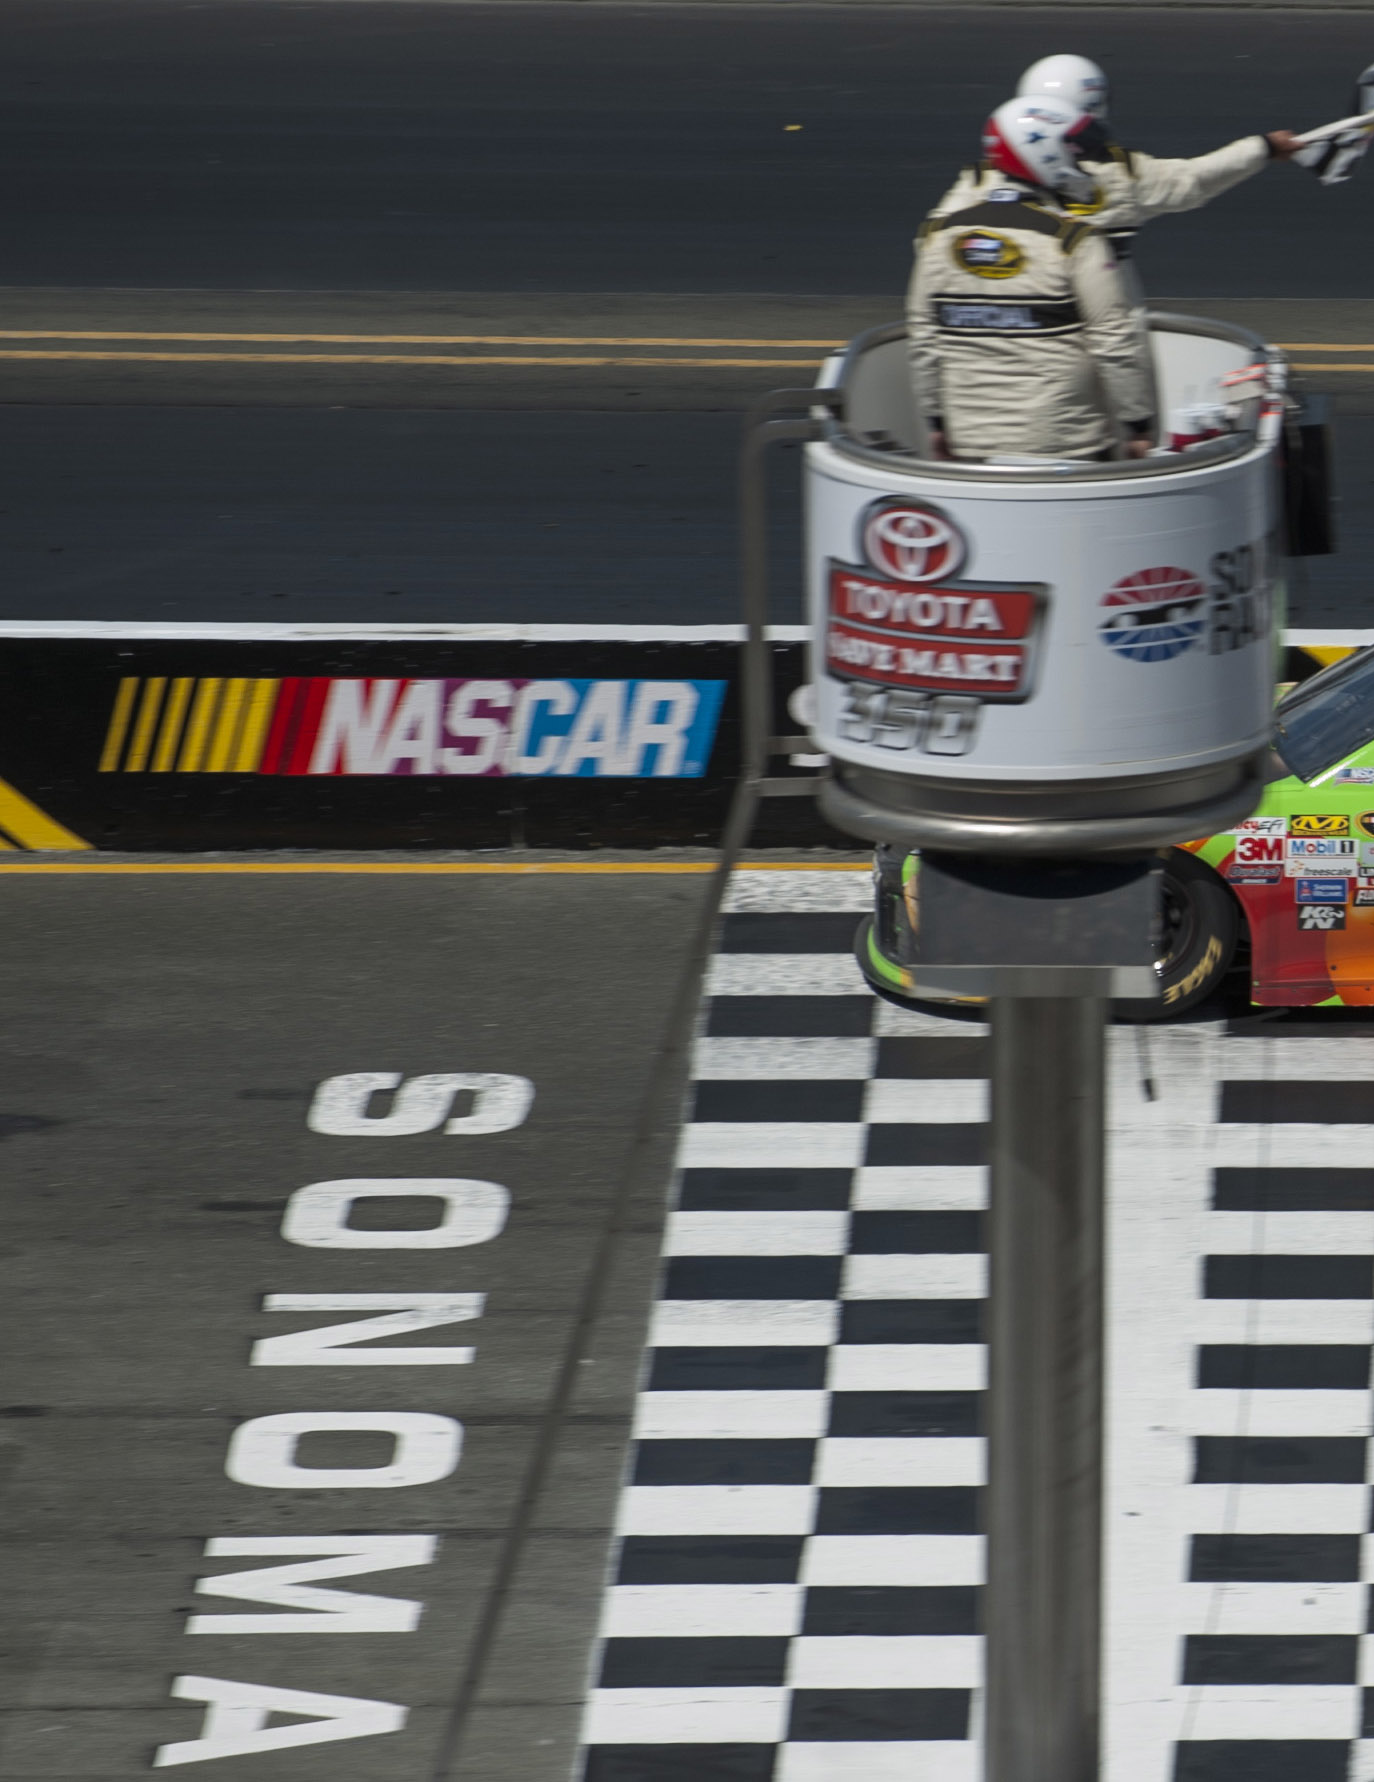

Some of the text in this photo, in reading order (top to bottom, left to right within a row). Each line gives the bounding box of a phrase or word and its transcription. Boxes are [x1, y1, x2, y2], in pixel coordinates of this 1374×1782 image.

[841, 581, 1003, 631] TOYOTA
[898, 645, 1022, 682] MART
[307, 679, 699, 776] NASCAR
[838, 682, 984, 756] 350
[1239, 838, 1283, 861] 3M
[1291, 840, 1335, 854] Mobil
[1303, 866, 1353, 876] freescale
[153, 1072, 535, 1767] SONOMA
